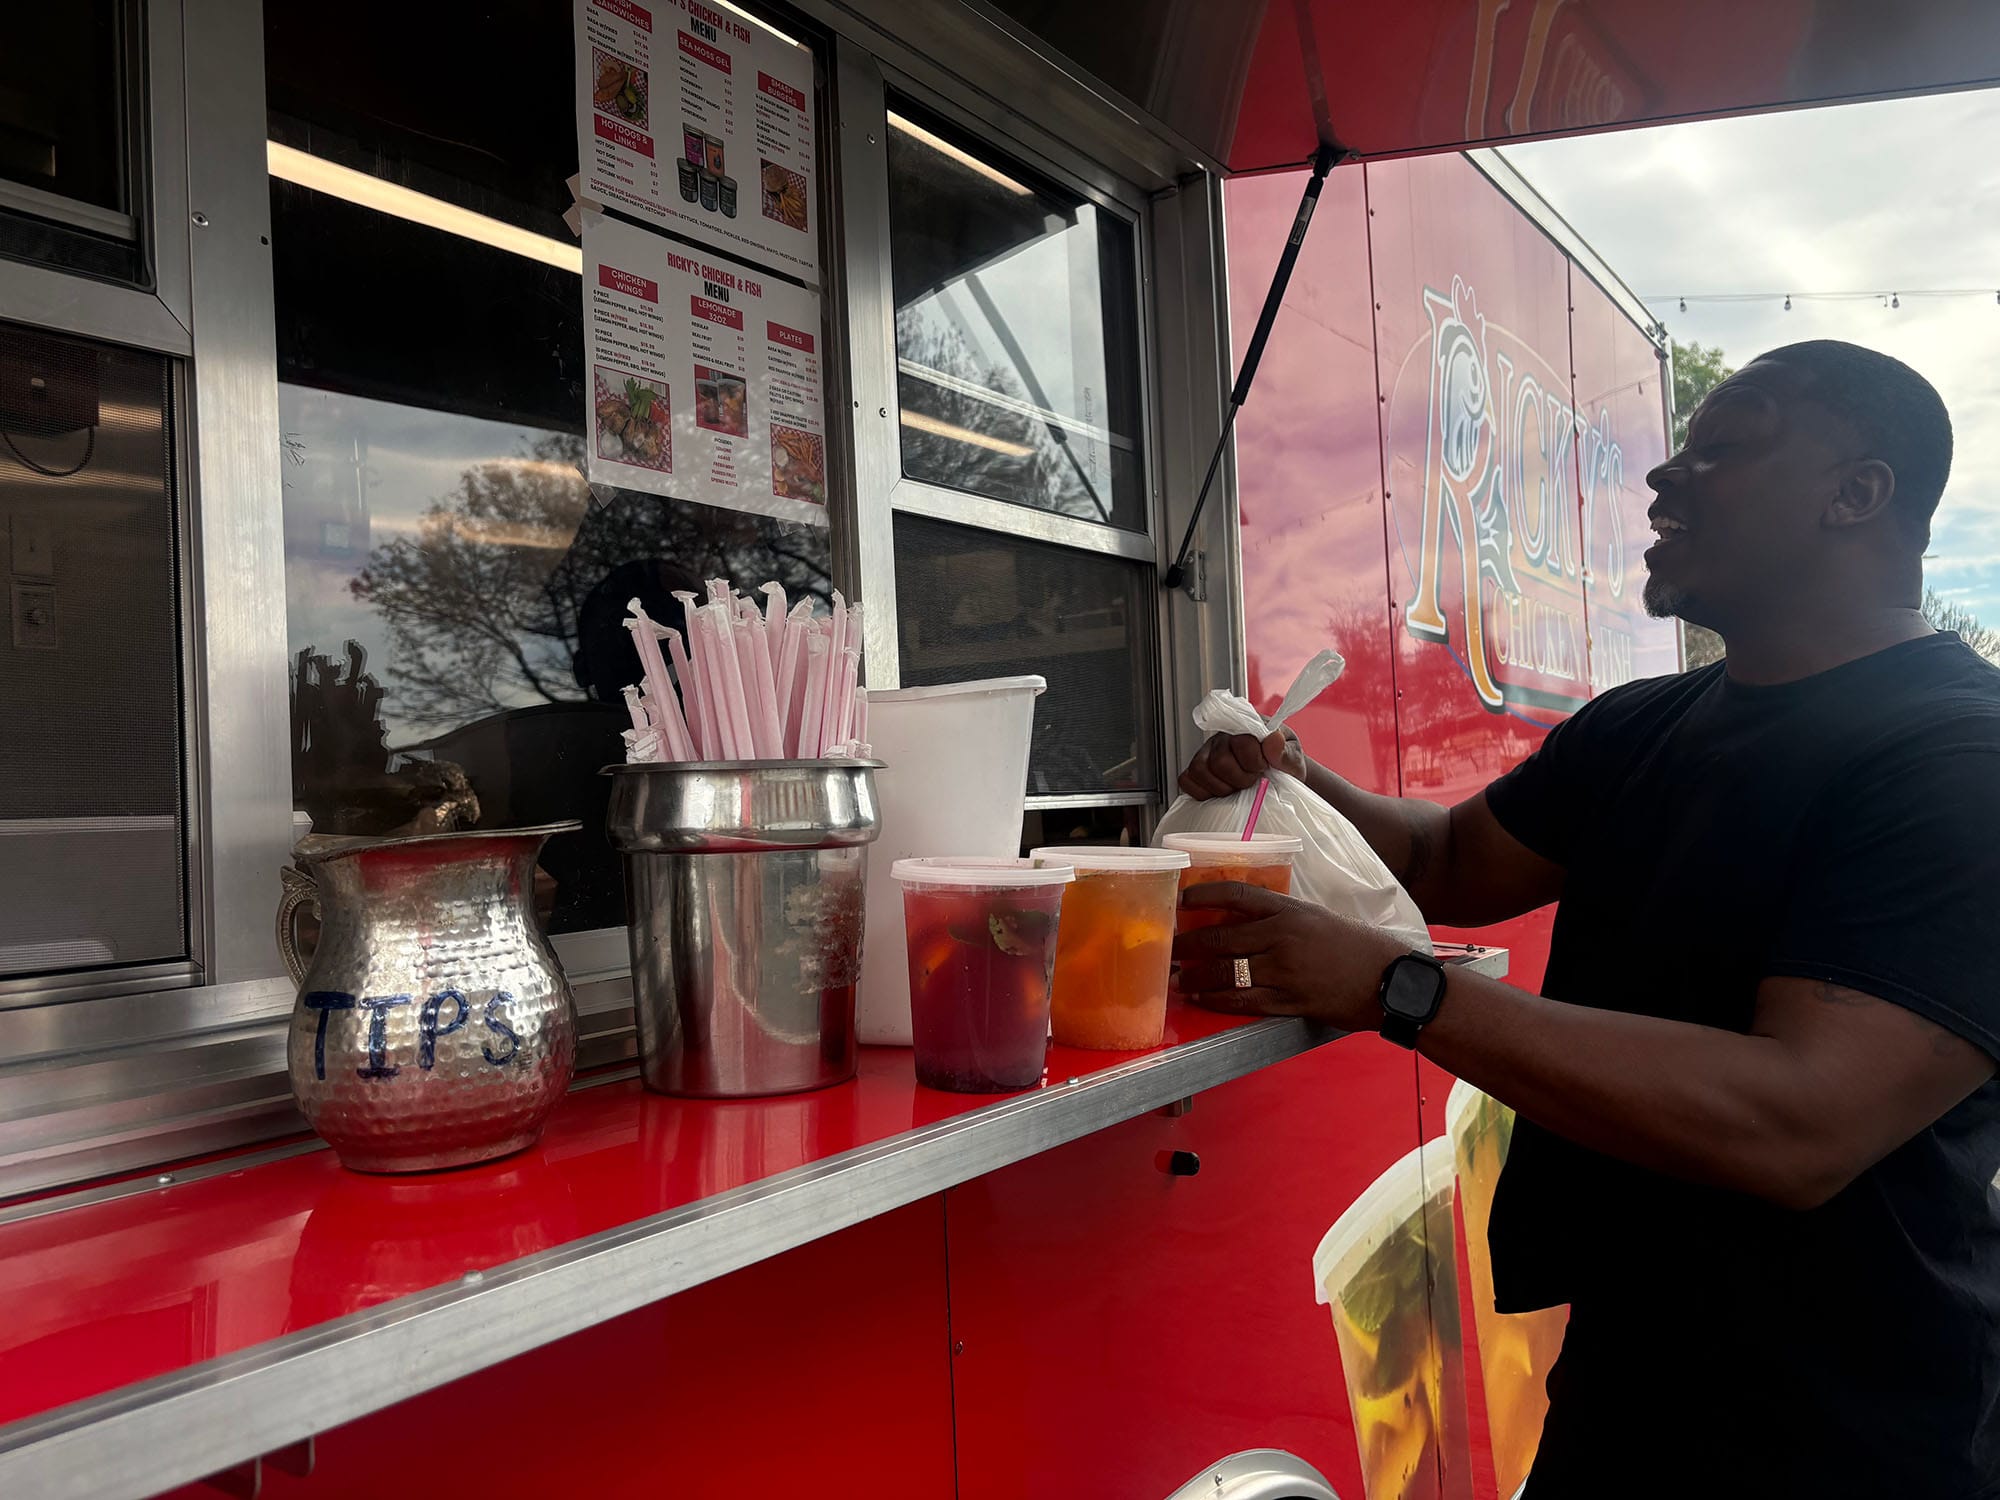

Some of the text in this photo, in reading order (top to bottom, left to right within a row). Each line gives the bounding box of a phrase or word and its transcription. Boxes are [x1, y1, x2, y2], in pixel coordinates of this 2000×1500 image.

[596, 0, 649, 29] SANDWICHES
[688, 0, 722, 29] CHICKEN
[726, 20, 731, 34] &
[734, 23, 751, 44] FISH
[691, 16, 716, 43] MENU
[597, 39, 616, 53] SNAPPER
[680, 37, 729, 68] SEA MOSS GEL
[681, 87, 705, 102] STRAWBERRY
[768, 79, 797, 106] SMASH BURGERS
[601, 117, 648, 145] HOTDOGS &
[614, 133, 637, 150] LINKS
[596, 148, 605, 156] HOT
[590, 177, 615, 192] TOPPINGS
[615, 187, 625, 196] FOR
[590, 184, 608, 197] SAUCE,
[630, 199, 644, 210] MAYO,
[645, 206, 666, 218] KETCHUP
[611, 270, 647, 288] CHICKEN
[667, 251, 762, 298] RICKY'S CHICKEN & FISH
[597, 290, 609, 299] PIECE
[616, 281, 643, 297] WINGS
[704, 280, 729, 303] MENU
[593, 295, 611, 306] (LEMON
[639, 310, 647, 318] HOT
[648, 312, 664, 323] WINGS)
[598, 309, 610, 318] PIECE
[698, 299, 736, 318] LEMONADE
[709, 313, 727, 324] 32OZ
[594, 314, 611, 325] (LEMON
[639, 328, 648, 336] HOT
[649, 331, 664, 342] WINGS)
[601, 329, 612, 337] PIECE
[780, 331, 802, 345] PLATES
[595, 334, 612, 345] (LEMON
[640, 348, 649, 356] HOT
[649, 351, 666, 361] WINGS)
[601, 348, 613, 356] PIECE
[596, 353, 613, 364] (LEMON
[641, 366, 649, 374] HOT
[650, 369, 666, 379] WINGS)
[1406, 280, 1625, 712] RICKY'S
[1492, 585, 1588, 684] CHICKEN
[303, 987, 522, 1083] TIPS
